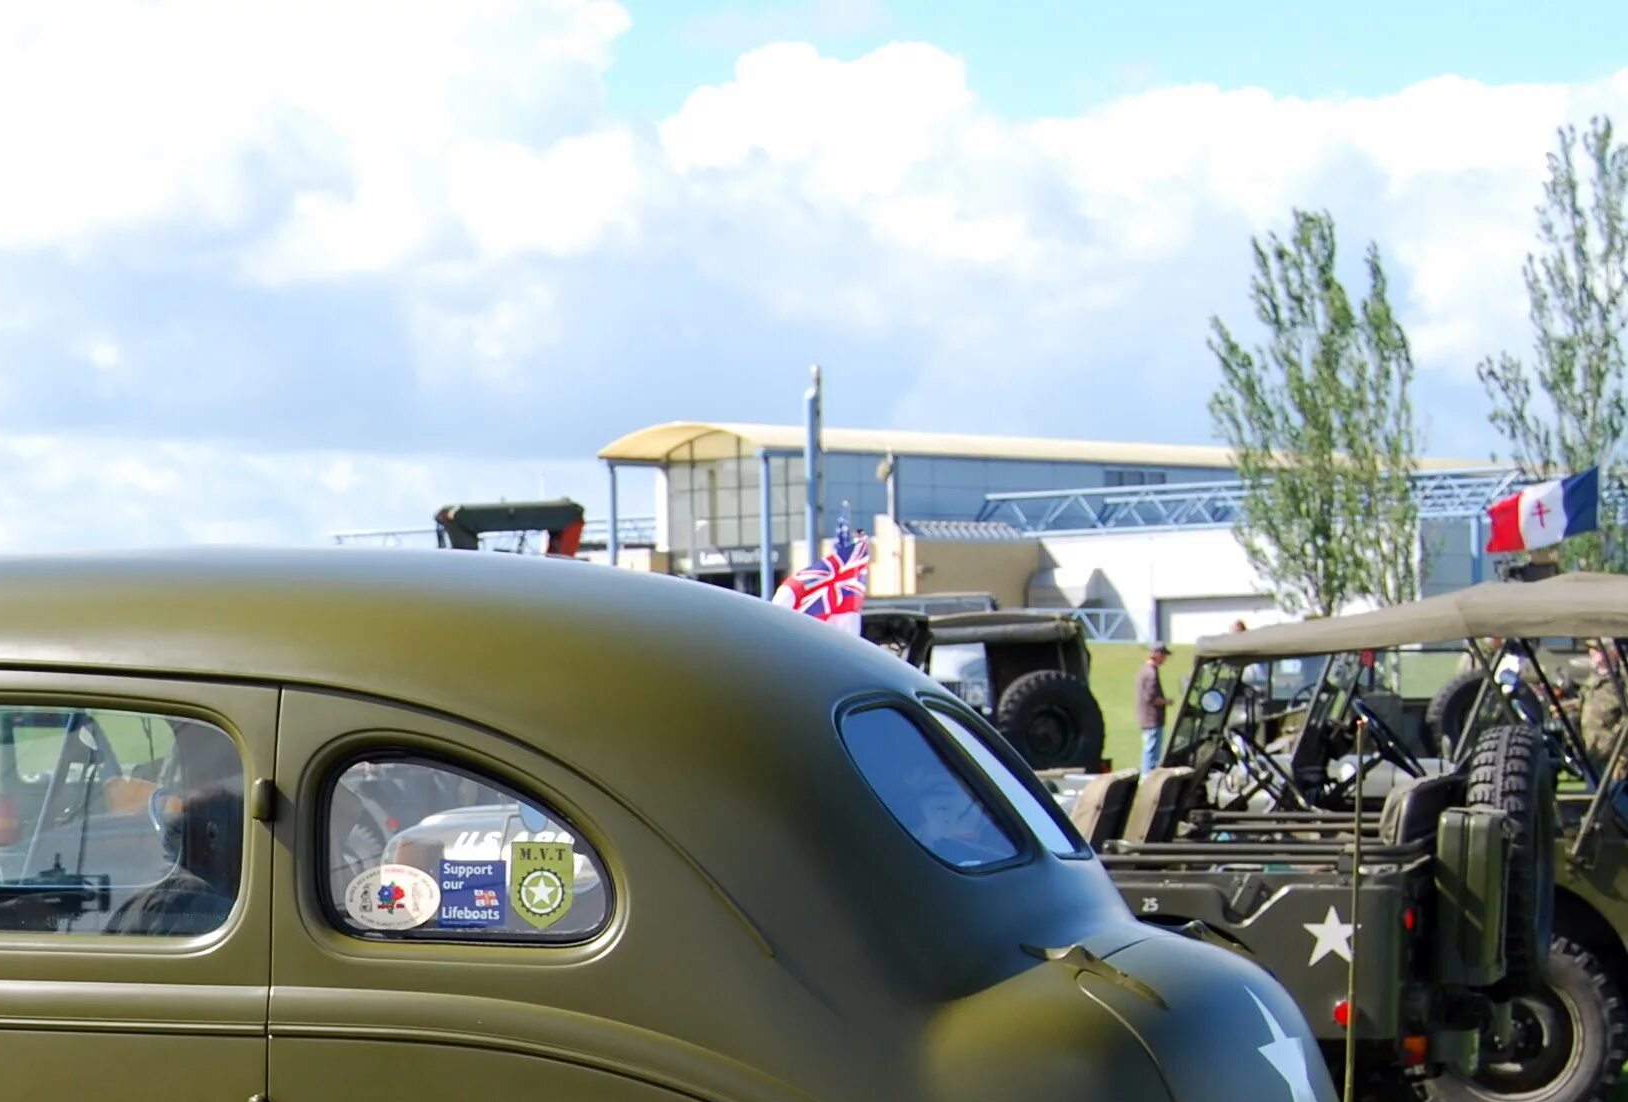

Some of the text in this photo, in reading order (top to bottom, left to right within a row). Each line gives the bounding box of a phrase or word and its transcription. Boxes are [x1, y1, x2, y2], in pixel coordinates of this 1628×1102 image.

[443, 862, 494, 879] Support
[442, 880, 465, 891] our
[1141, 896, 1159, 913] 25
[441, 906, 500, 921] Lifeboats
